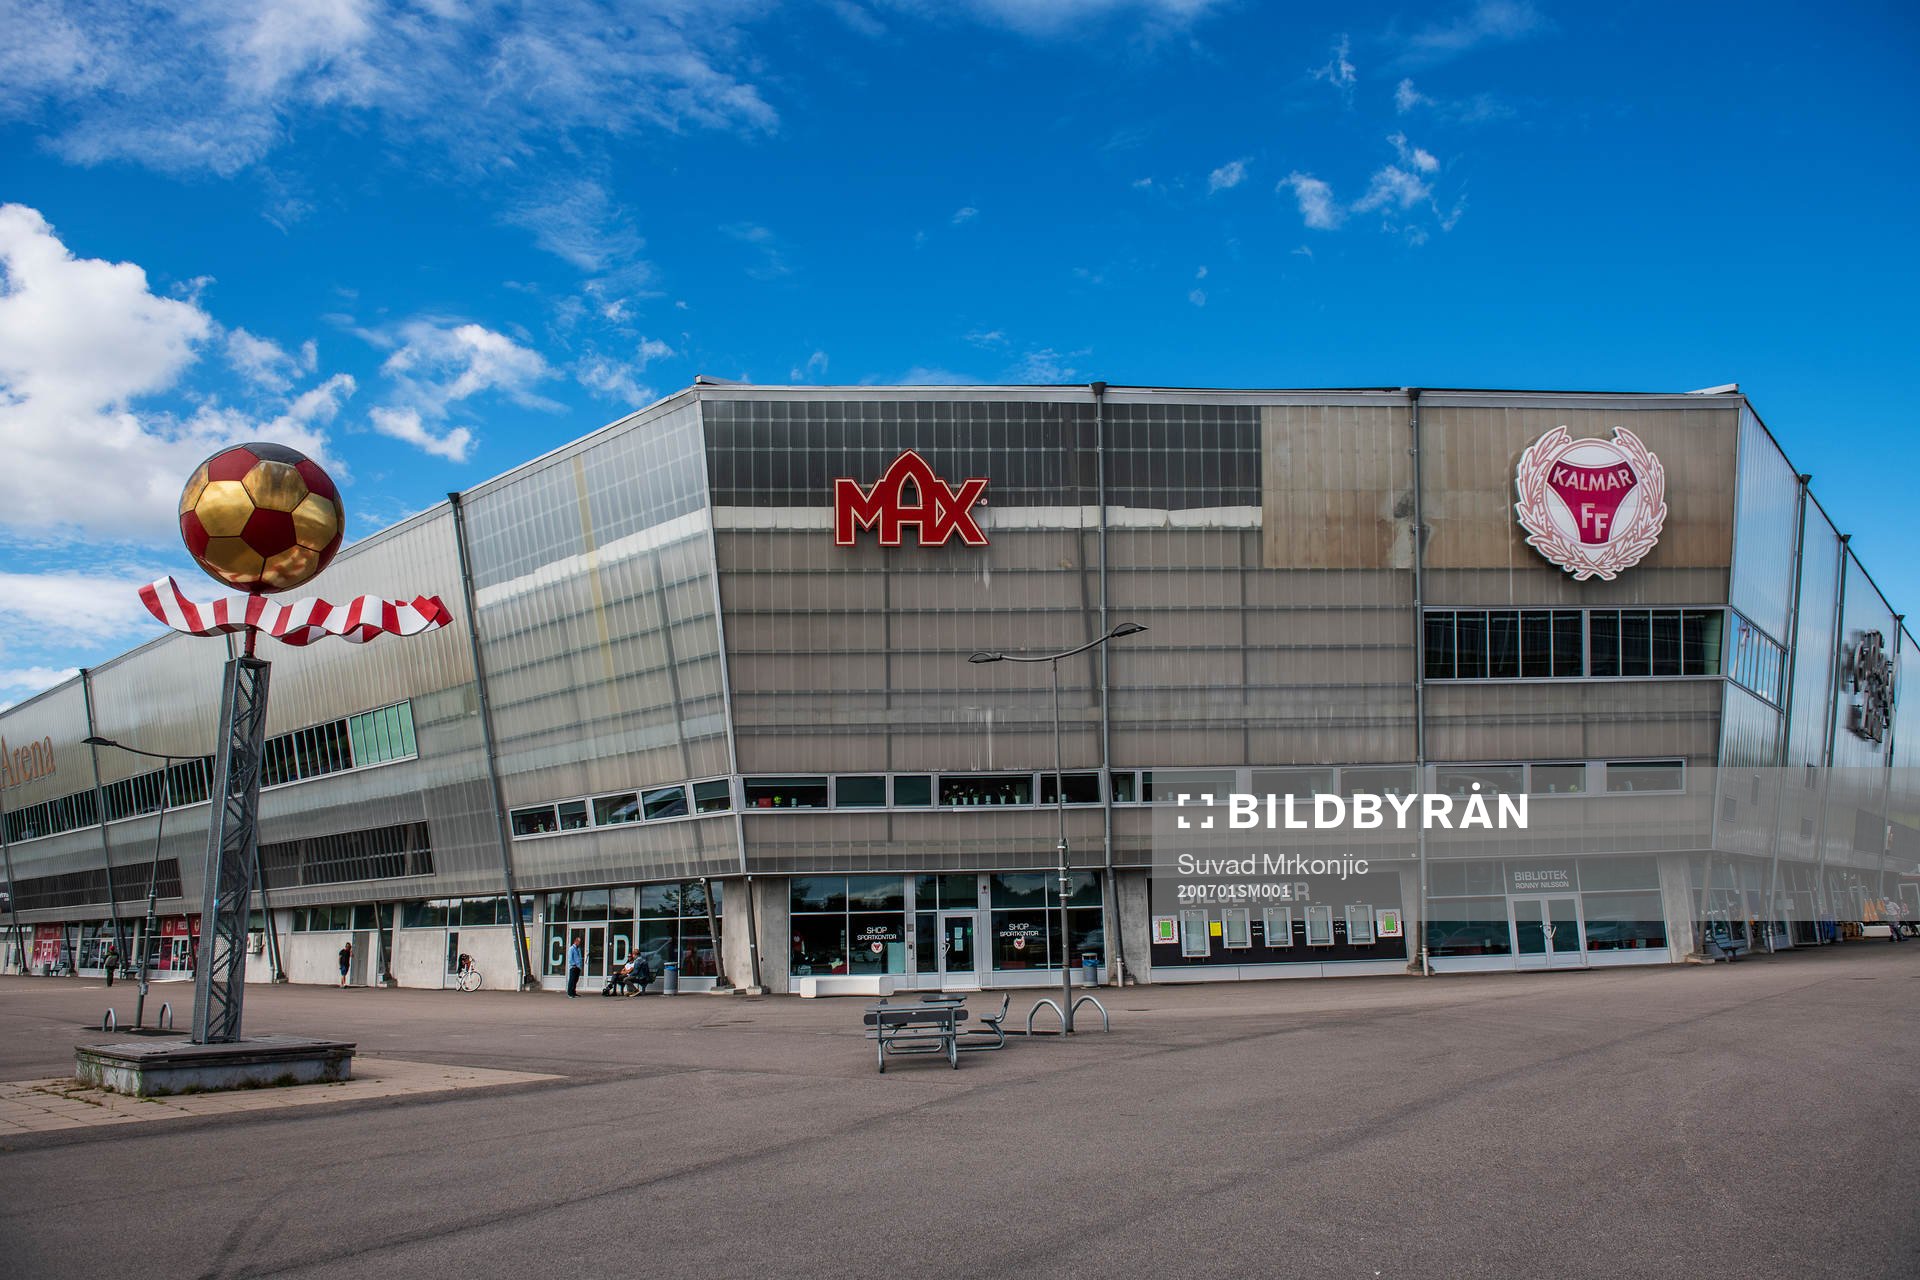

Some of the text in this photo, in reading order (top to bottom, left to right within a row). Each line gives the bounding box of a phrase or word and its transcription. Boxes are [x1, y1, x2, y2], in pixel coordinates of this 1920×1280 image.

[1552, 466, 1633, 492] KALMAR
[834, 448, 991, 546] MAX
[1581, 503, 1609, 539] FF
[0, 735, 56, 790] Arena
[1514, 870, 1568, 881] BIBLIOTEK
[866, 926, 888, 934] SHOP
[550, 936, 564, 966] C
[613, 934, 630, 965] D
